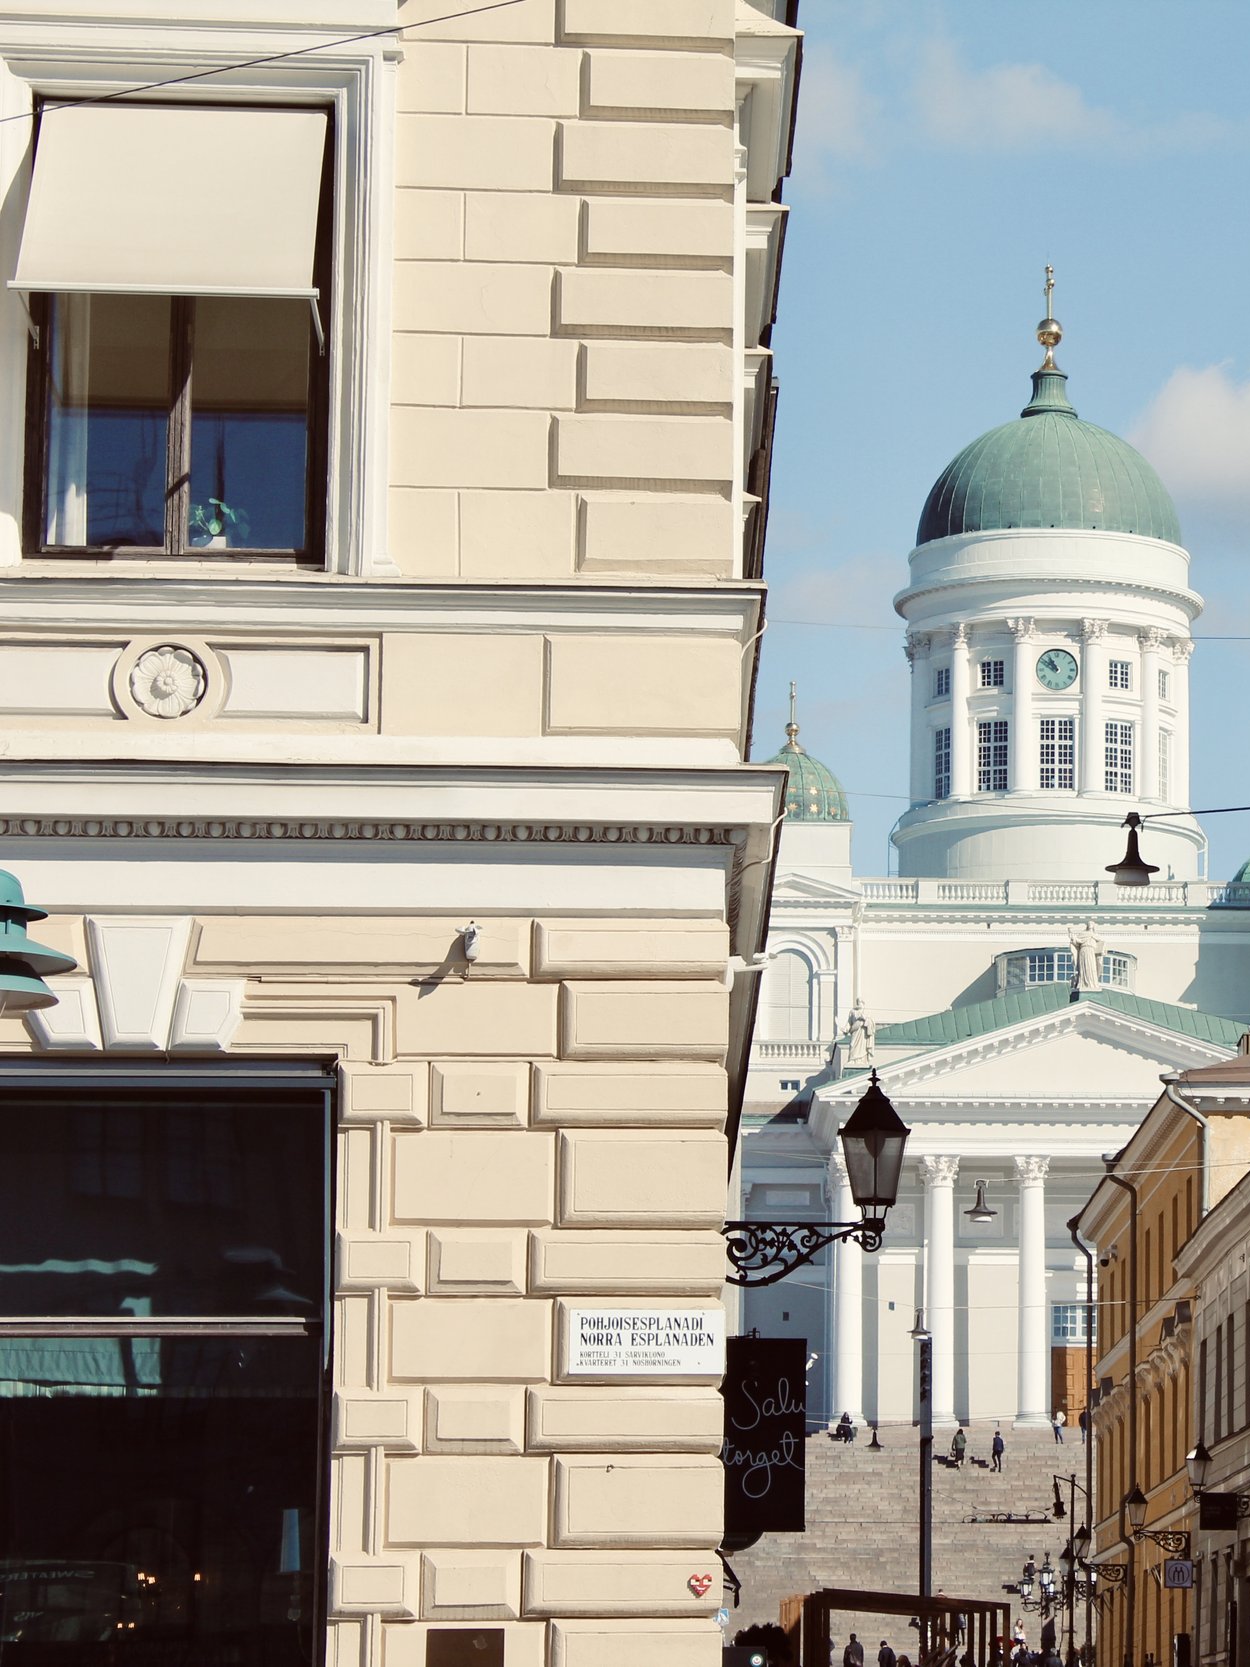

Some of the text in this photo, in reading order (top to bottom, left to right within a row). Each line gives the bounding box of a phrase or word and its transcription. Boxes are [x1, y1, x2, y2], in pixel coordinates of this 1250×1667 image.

[580, 1317, 703, 1330] POHJOISESPLANADI
[580, 1333, 714, 1346] NORRA ESPLANADEN
[723, 1431, 805, 1498] torget
